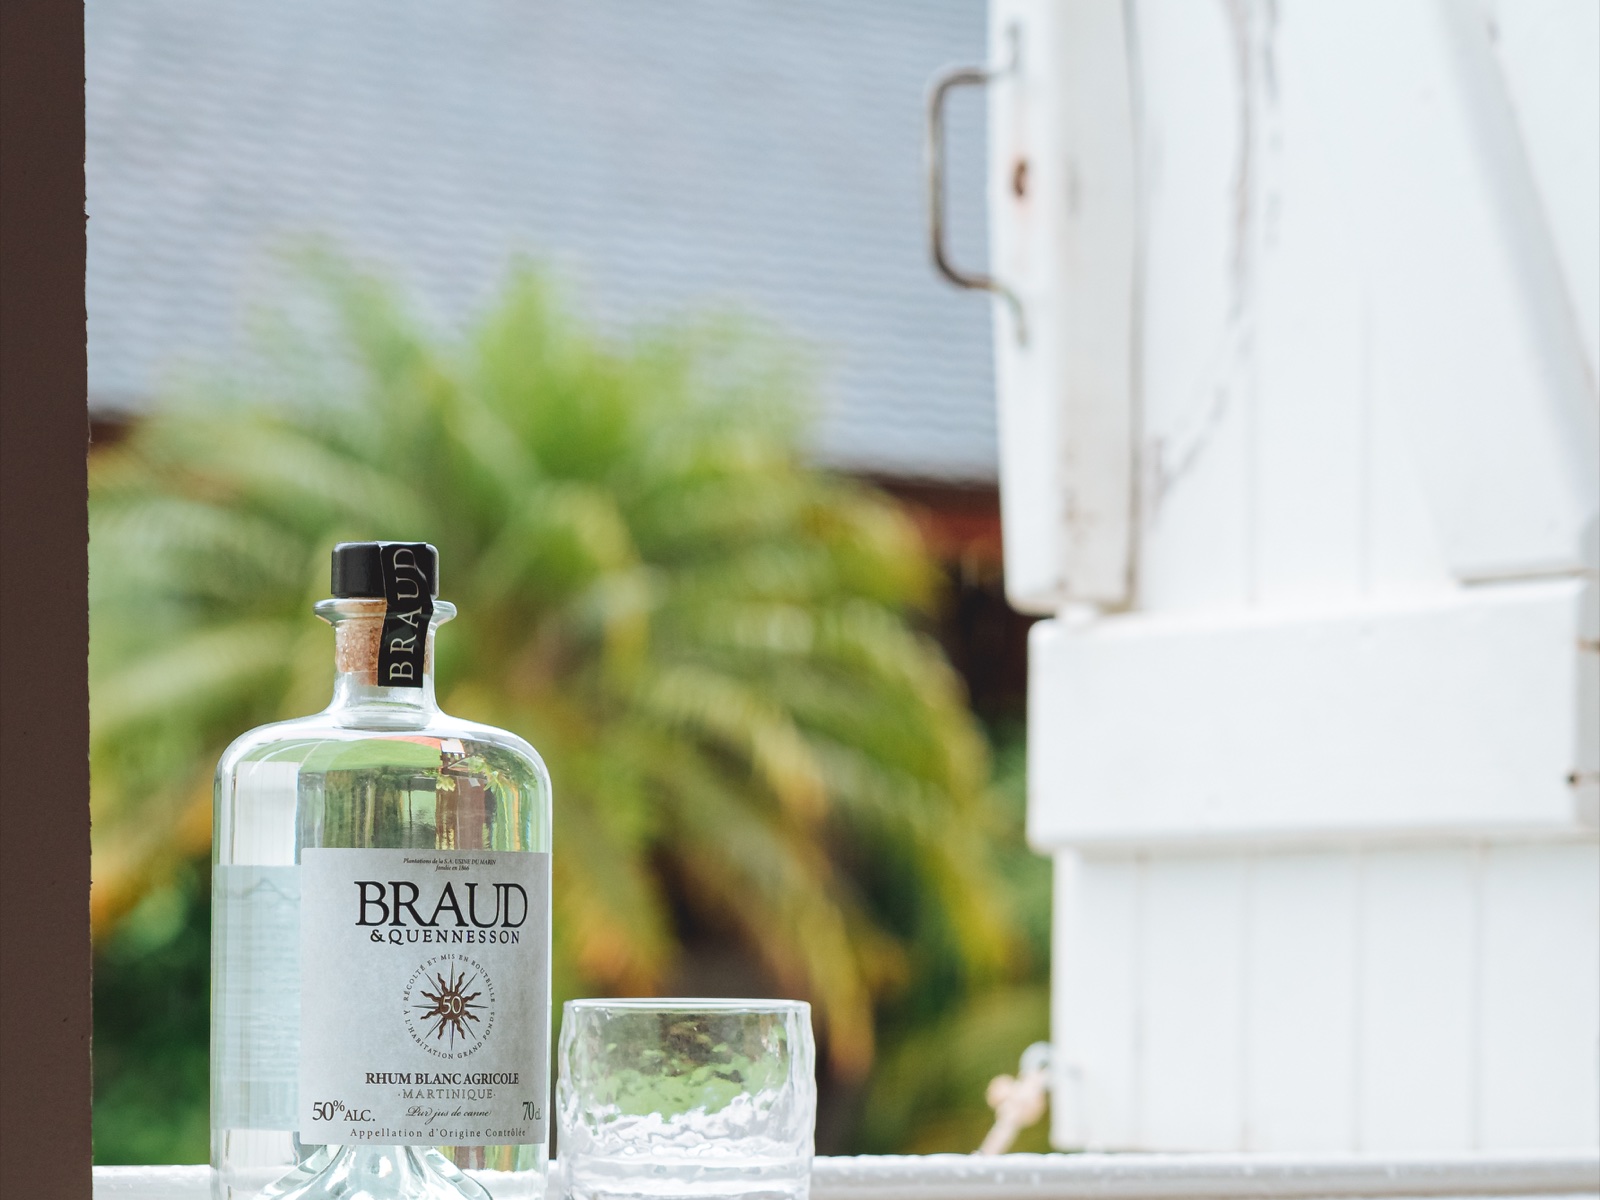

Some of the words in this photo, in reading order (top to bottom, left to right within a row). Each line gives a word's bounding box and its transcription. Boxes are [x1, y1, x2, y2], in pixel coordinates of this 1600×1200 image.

[389, 548, 423, 680] BRAUD
[354, 881, 528, 928] BRAUD
[427, 957, 437, 966] ET
[440, 953, 455, 961] MIS
[458, 954, 469, 962] EN
[441, 995, 462, 1014] 50
[482, 1011, 495, 1041] FONDS
[457, 1042, 482, 1059] GRAND
[365, 1072, 411, 1085] RHUM
[414, 1073, 462, 1085] BLANC
[463, 1072, 519, 1085] AGRICOLE
[405, 1105, 433, 1117] Pur
[424, 1108, 448, 1125] jus
[450, 1105, 462, 1117] de
[350, 1128, 422, 1139] Appellation
[428, 1128, 481, 1140] d'Origine
[485, 1128, 526, 1137] Contrôlée
